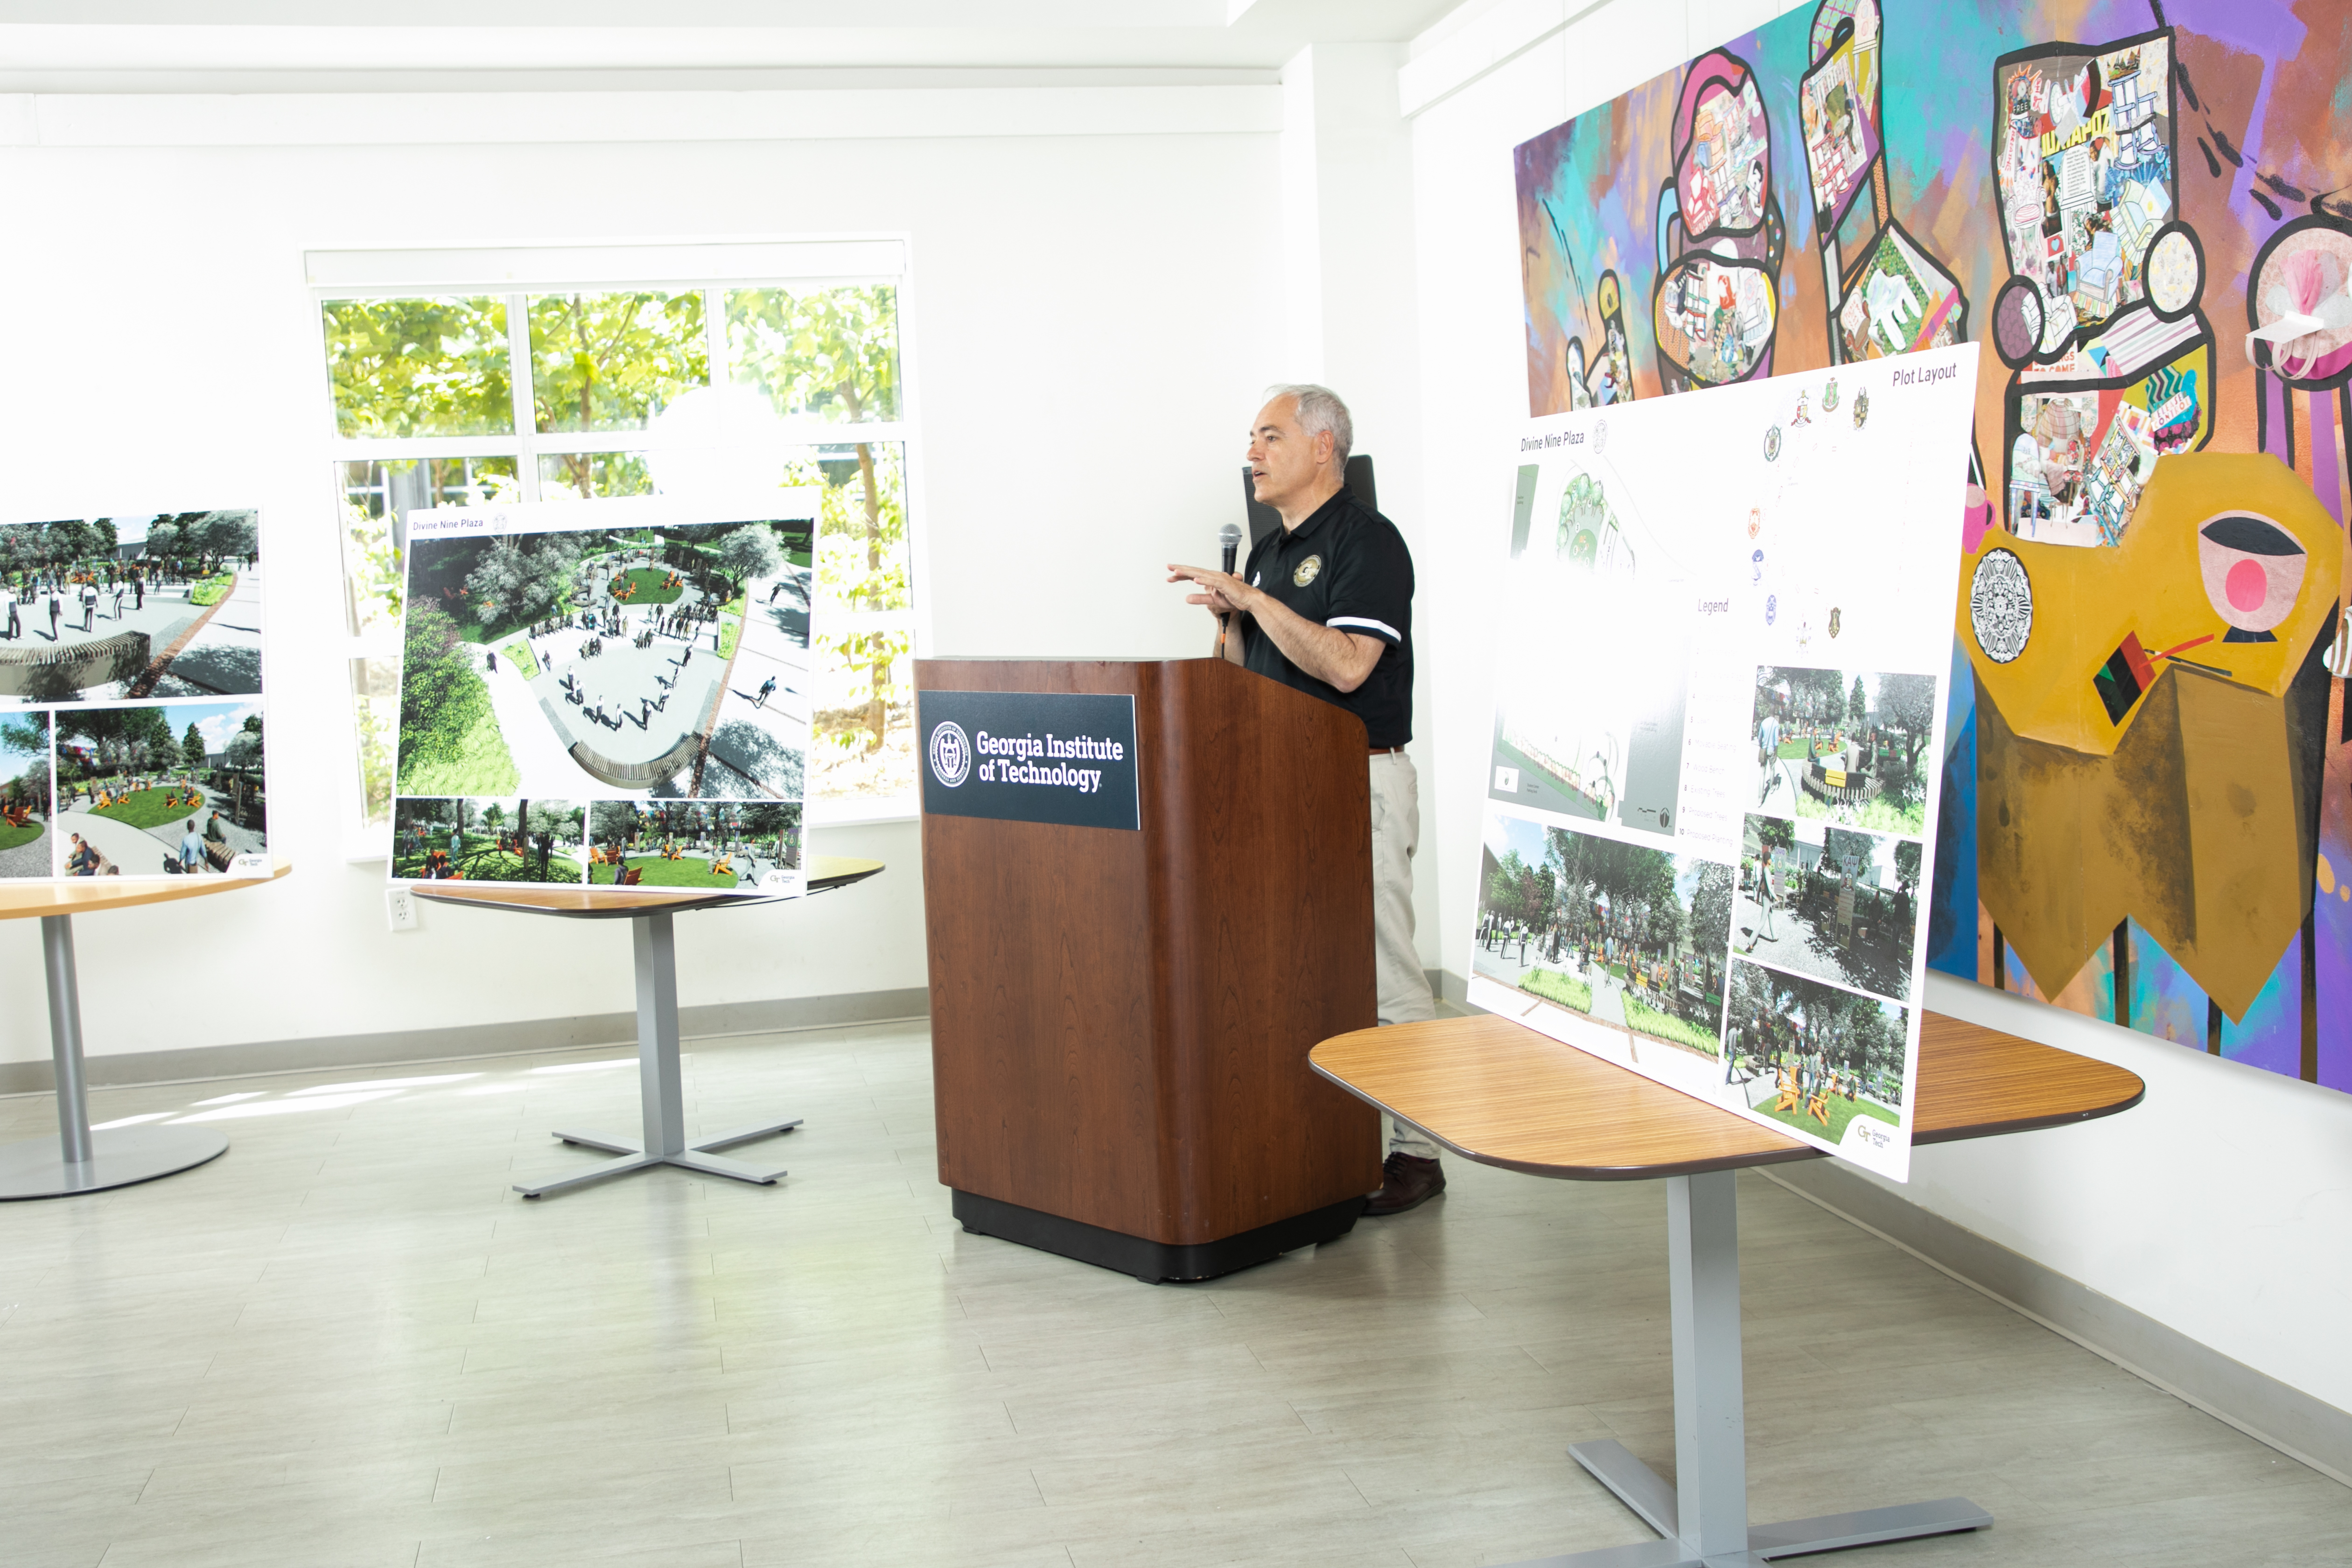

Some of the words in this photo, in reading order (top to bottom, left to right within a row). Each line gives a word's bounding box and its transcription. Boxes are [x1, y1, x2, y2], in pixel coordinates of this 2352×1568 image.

[2013, 102, 2028, 113] FREE
[1893, 371, 1915, 387] Plot
[1918, 364, 1957, 384] Layout
[2154, 399, 2190, 428] CONTROL
[1521, 436, 1543, 452] Divine
[1545, 434, 1561, 448] Nine
[1563, 430, 1584, 446] Plaza
[413, 521, 437, 530] Divine
[440, 519, 458, 529] Nine
[461, 518, 483, 527] Plaza
[1698, 598, 1729, 616] Legend
[977, 731, 1043, 761] Georgia
[1046, 734, 1123, 761] Institute
[1717, 741, 1736, 752] Seating
[979, 759, 995, 781] of
[998, 760, 1101, 792] Technology
[1709, 765, 1725, 774] Bench
[1691, 785, 1710, 797] Existing
[1713, 788, 1725, 798] Trees
[1689, 807, 1712, 819] Proposed
[1715, 812, 1727, 821] Trees
[1687, 829, 1710, 841] Proposed
[1712, 834, 1733, 847] Planting
[1872, 1129, 1890, 1142] Georgia
[1873, 1137, 1883, 1148] Tech
